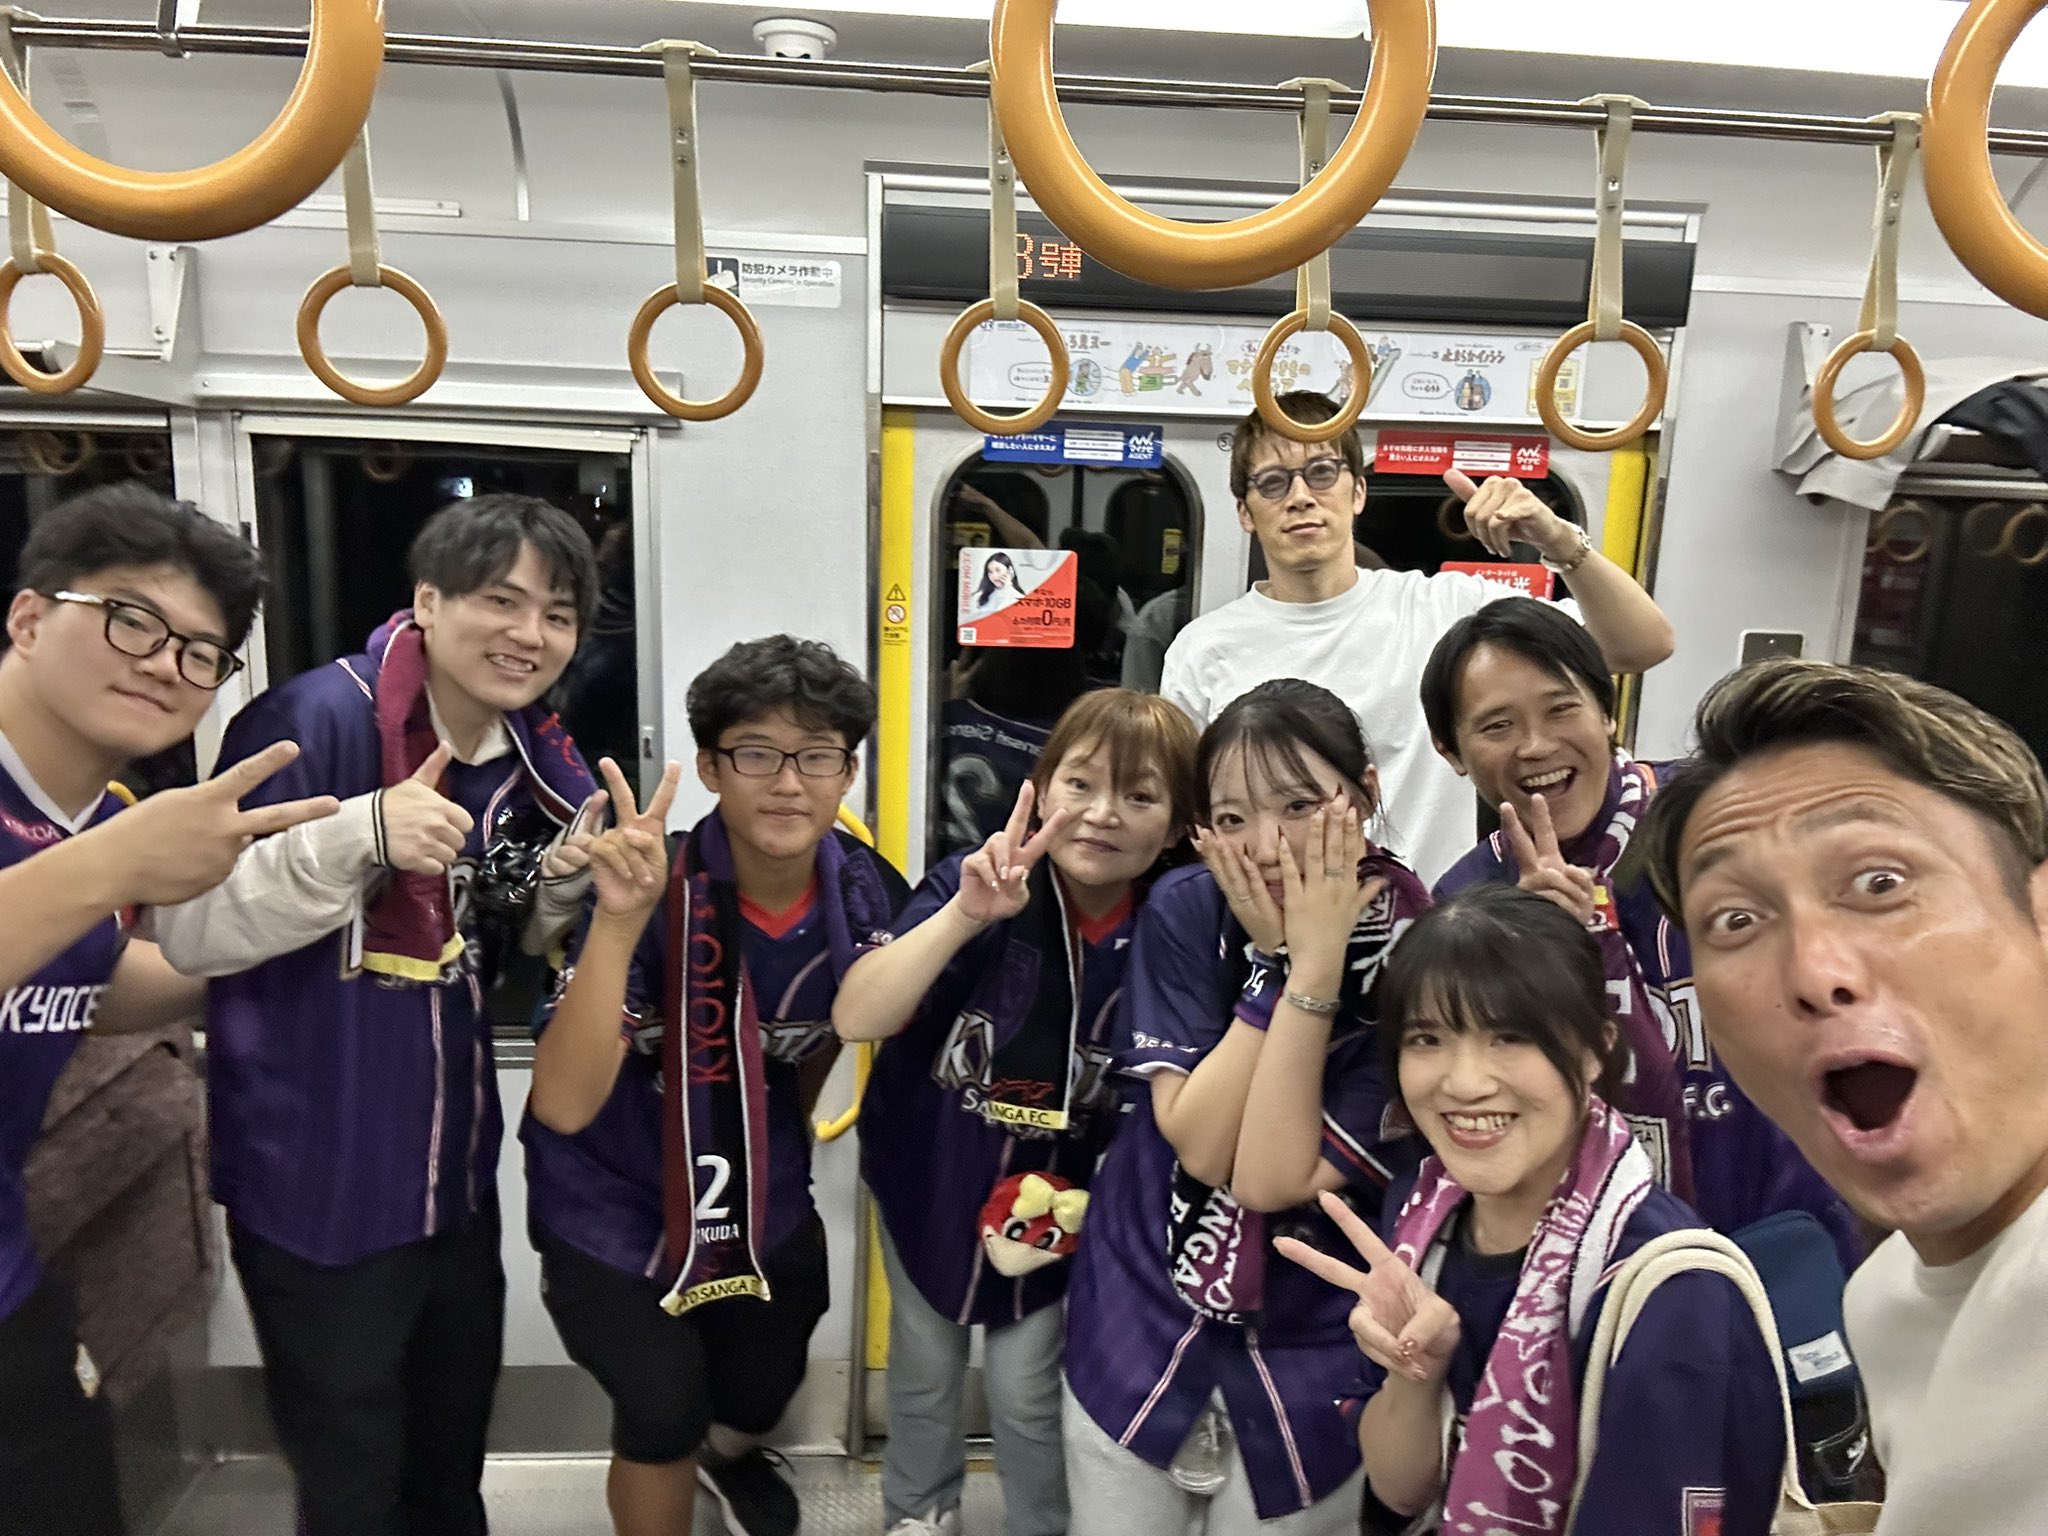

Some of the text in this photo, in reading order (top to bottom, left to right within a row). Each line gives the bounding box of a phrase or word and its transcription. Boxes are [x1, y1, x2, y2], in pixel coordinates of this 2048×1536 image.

[741, 262, 833, 278] 防犯カメラ作動中
[695, 1154, 731, 1220] 2
[699, 1279, 749, 1300] SANGA
